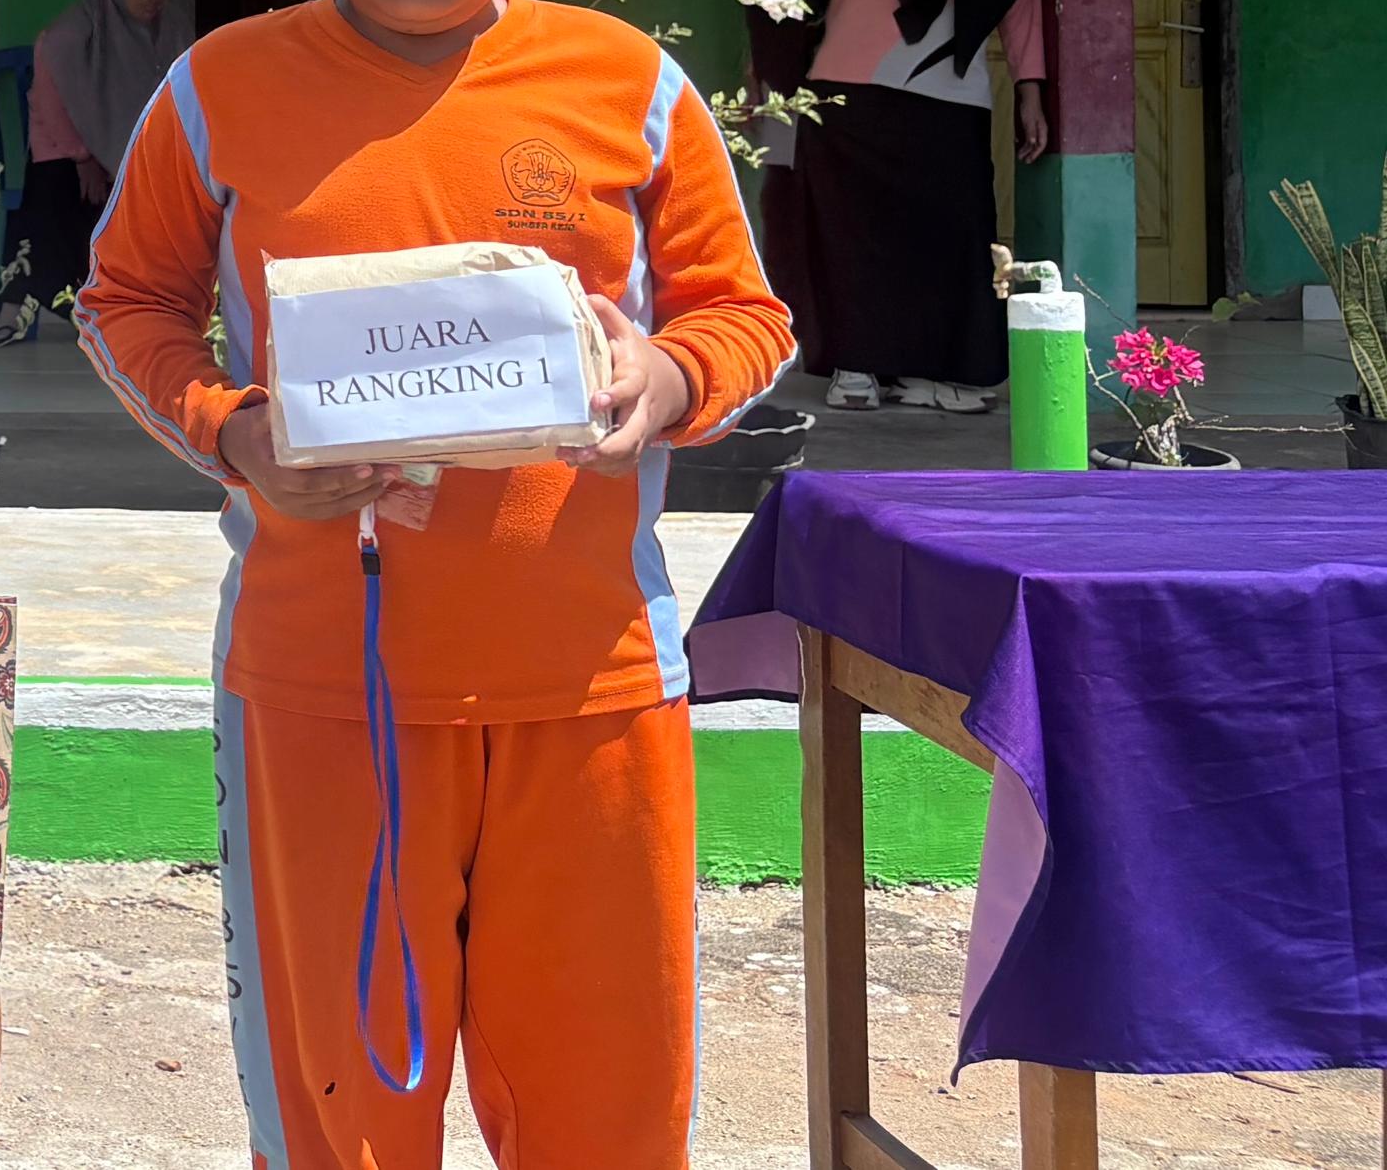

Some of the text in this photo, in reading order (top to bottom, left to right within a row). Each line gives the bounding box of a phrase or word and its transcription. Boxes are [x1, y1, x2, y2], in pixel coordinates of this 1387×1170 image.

[494, 208, 536, 219] SDN
[365, 317, 491, 356] JUARA
[316, 357, 553, 407] RANGKING 1
